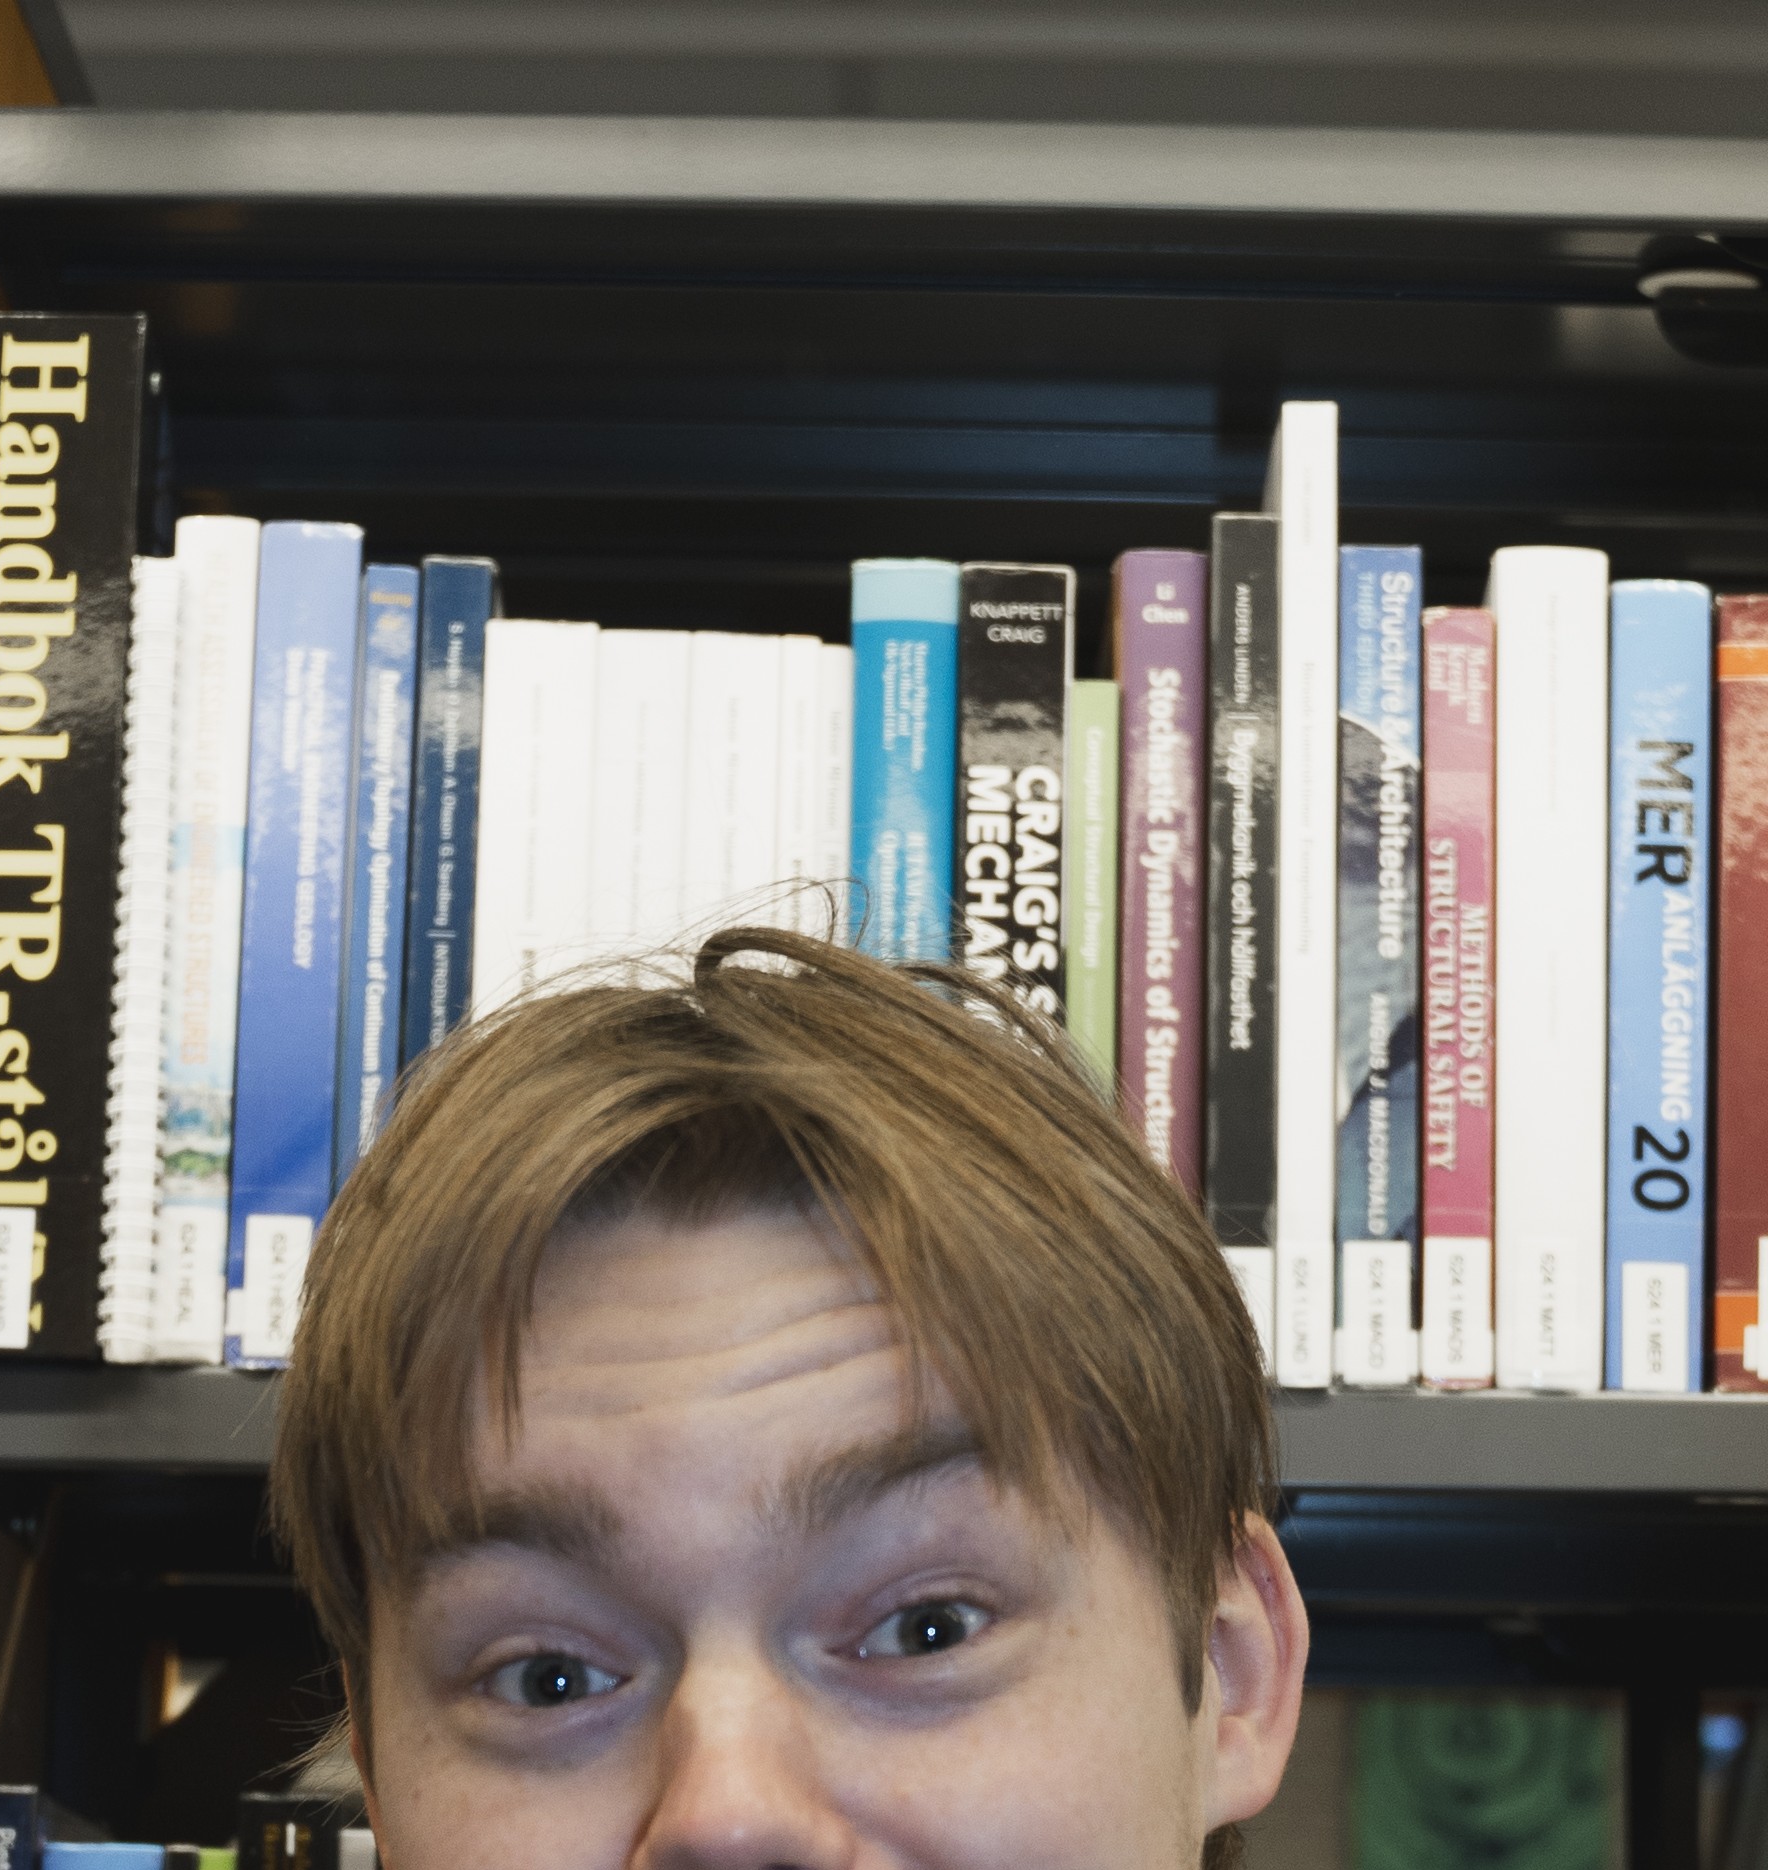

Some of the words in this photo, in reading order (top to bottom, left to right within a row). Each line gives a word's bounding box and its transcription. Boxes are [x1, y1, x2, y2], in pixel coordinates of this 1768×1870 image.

[970, 602, 1063, 621] KNAPPETT
[987, 624, 1047, 643] CRAIG
[1142, 604, 1189, 624] Chen
[1234, 583, 1252, 645] ANDERS
[1356, 572, 1377, 629] THIRD
[1355, 634, 1376, 715] EDITION
[1379, 571, 1415, 714] Structure
[1427, 643, 1450, 691] Lind
[1446, 645, 1468, 707] Krenk
[1466, 646, 1490, 725] Madsen
[1147, 668, 1182, 825] Stochastic
[1378, 717, 1414, 743] &
[369, 776, 395, 850] Topology
[1226, 729, 1258, 879] Byggmekanik
[1635, 740, 1698, 885] MER
[1013, 765, 1061, 972] CRAIG'S
[1378, 743, 1416, 959] Architecture
[293, 879, 316, 968] GEOLOGY
[1139, 829, 1180, 979] Dynamics
[1231, 879, 1257, 926] och
[368, 960, 387, 979] of
[1428, 837, 1459, 1050] STRUCTURAL
[1457, 902, 1490, 1059] METHODS
[180, 932, 212, 1065] STRUCTURES
[1145, 983, 1180, 1023] of
[1369, 992, 1390, 1070] ANGUS
[1660, 889, 1699, 1123] ANLÄGGNING
[1425, 1053, 1456, 1172] SAFETY
[1457, 1064, 1488, 1109] OF
[1367, 1096, 1391, 1235] MACDONALD
[1631, 1125, 1692, 1213] 20
